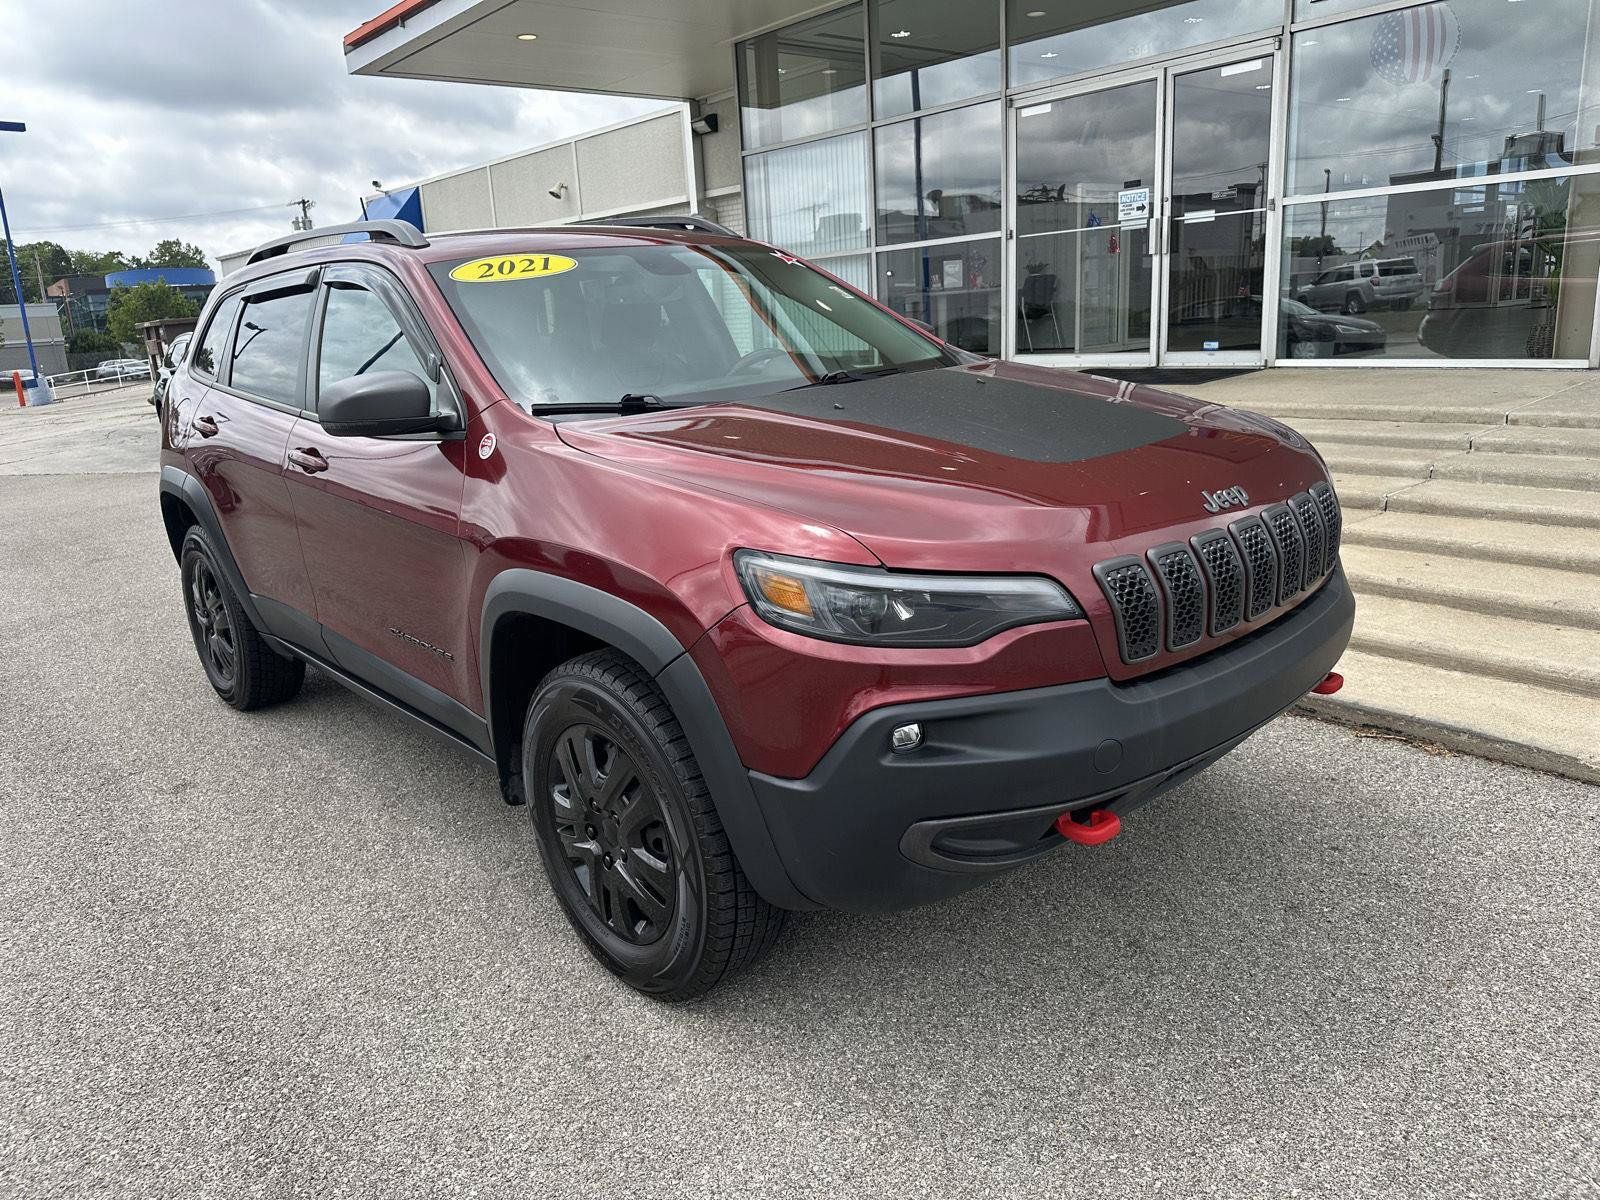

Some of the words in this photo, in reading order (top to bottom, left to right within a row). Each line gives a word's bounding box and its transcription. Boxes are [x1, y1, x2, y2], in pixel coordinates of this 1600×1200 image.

[1121, 193, 1146, 203] NOTICE
[478, 257, 552, 279] 2021
[1201, 485, 1249, 512] Jeep
